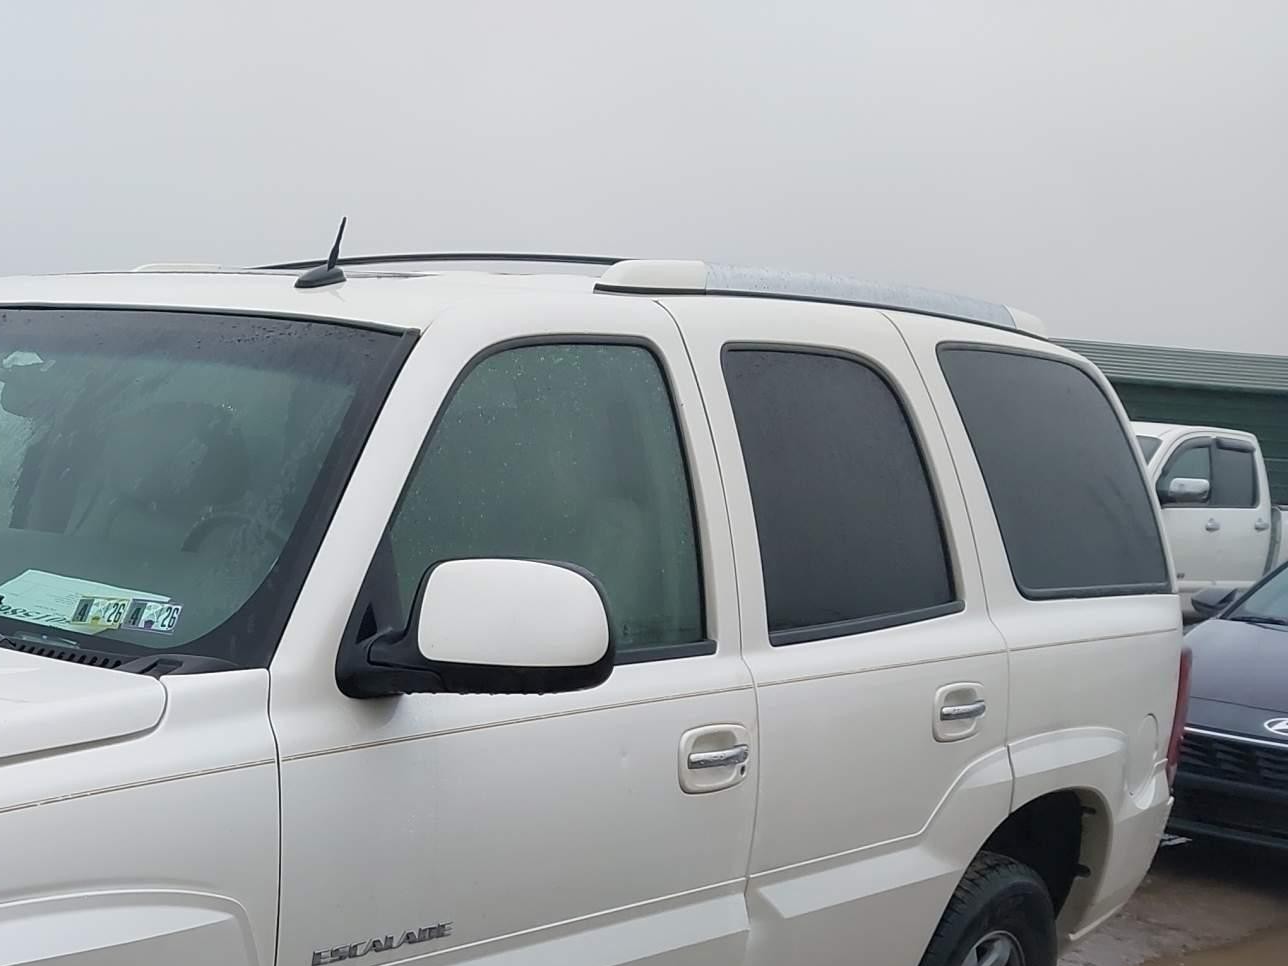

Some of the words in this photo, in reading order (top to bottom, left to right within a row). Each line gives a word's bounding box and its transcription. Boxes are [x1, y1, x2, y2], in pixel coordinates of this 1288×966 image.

[78, 603, 89, 621] 4
[107, 602, 126, 623] 26
[131, 607, 142, 625] 4
[160, 605, 180, 628] 26
[311, 921, 454, 966] ESCALADE
